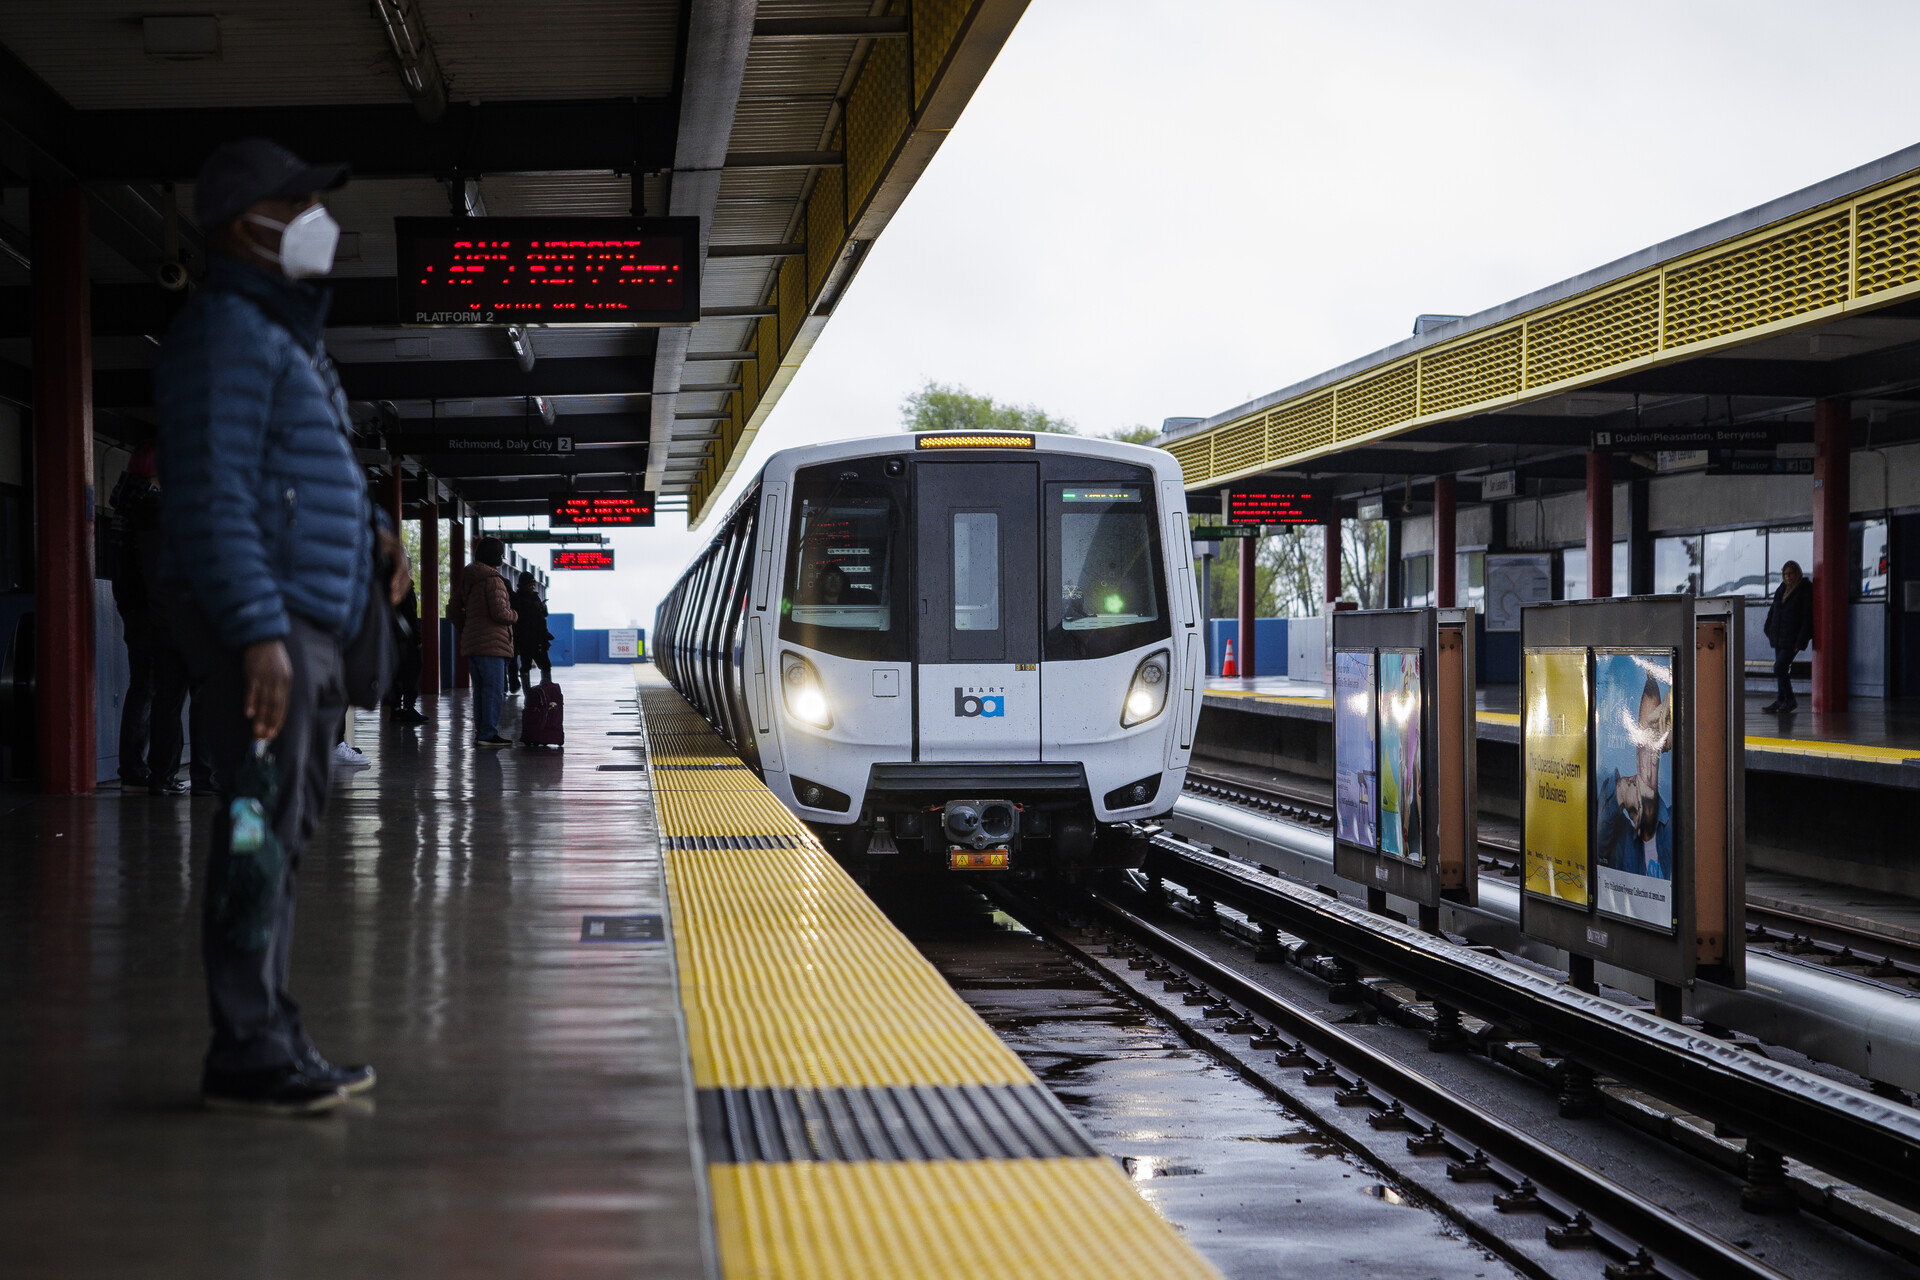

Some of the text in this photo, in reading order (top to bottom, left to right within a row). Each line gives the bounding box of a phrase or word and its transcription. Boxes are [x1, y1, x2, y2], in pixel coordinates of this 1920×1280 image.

[416, 312, 494, 322] PLATFORM 2
[1615, 432, 1714, 443] Dublin/Pleasanton,
[1717, 431, 1767, 442] Berryessa
[449, 439, 503, 450] Richmond,
[507, 439, 529, 452] Daly
[532, 439, 553, 451] City
[1529, 752, 1581, 780] The Operating System
[1538, 780, 1567, 804] for Business
